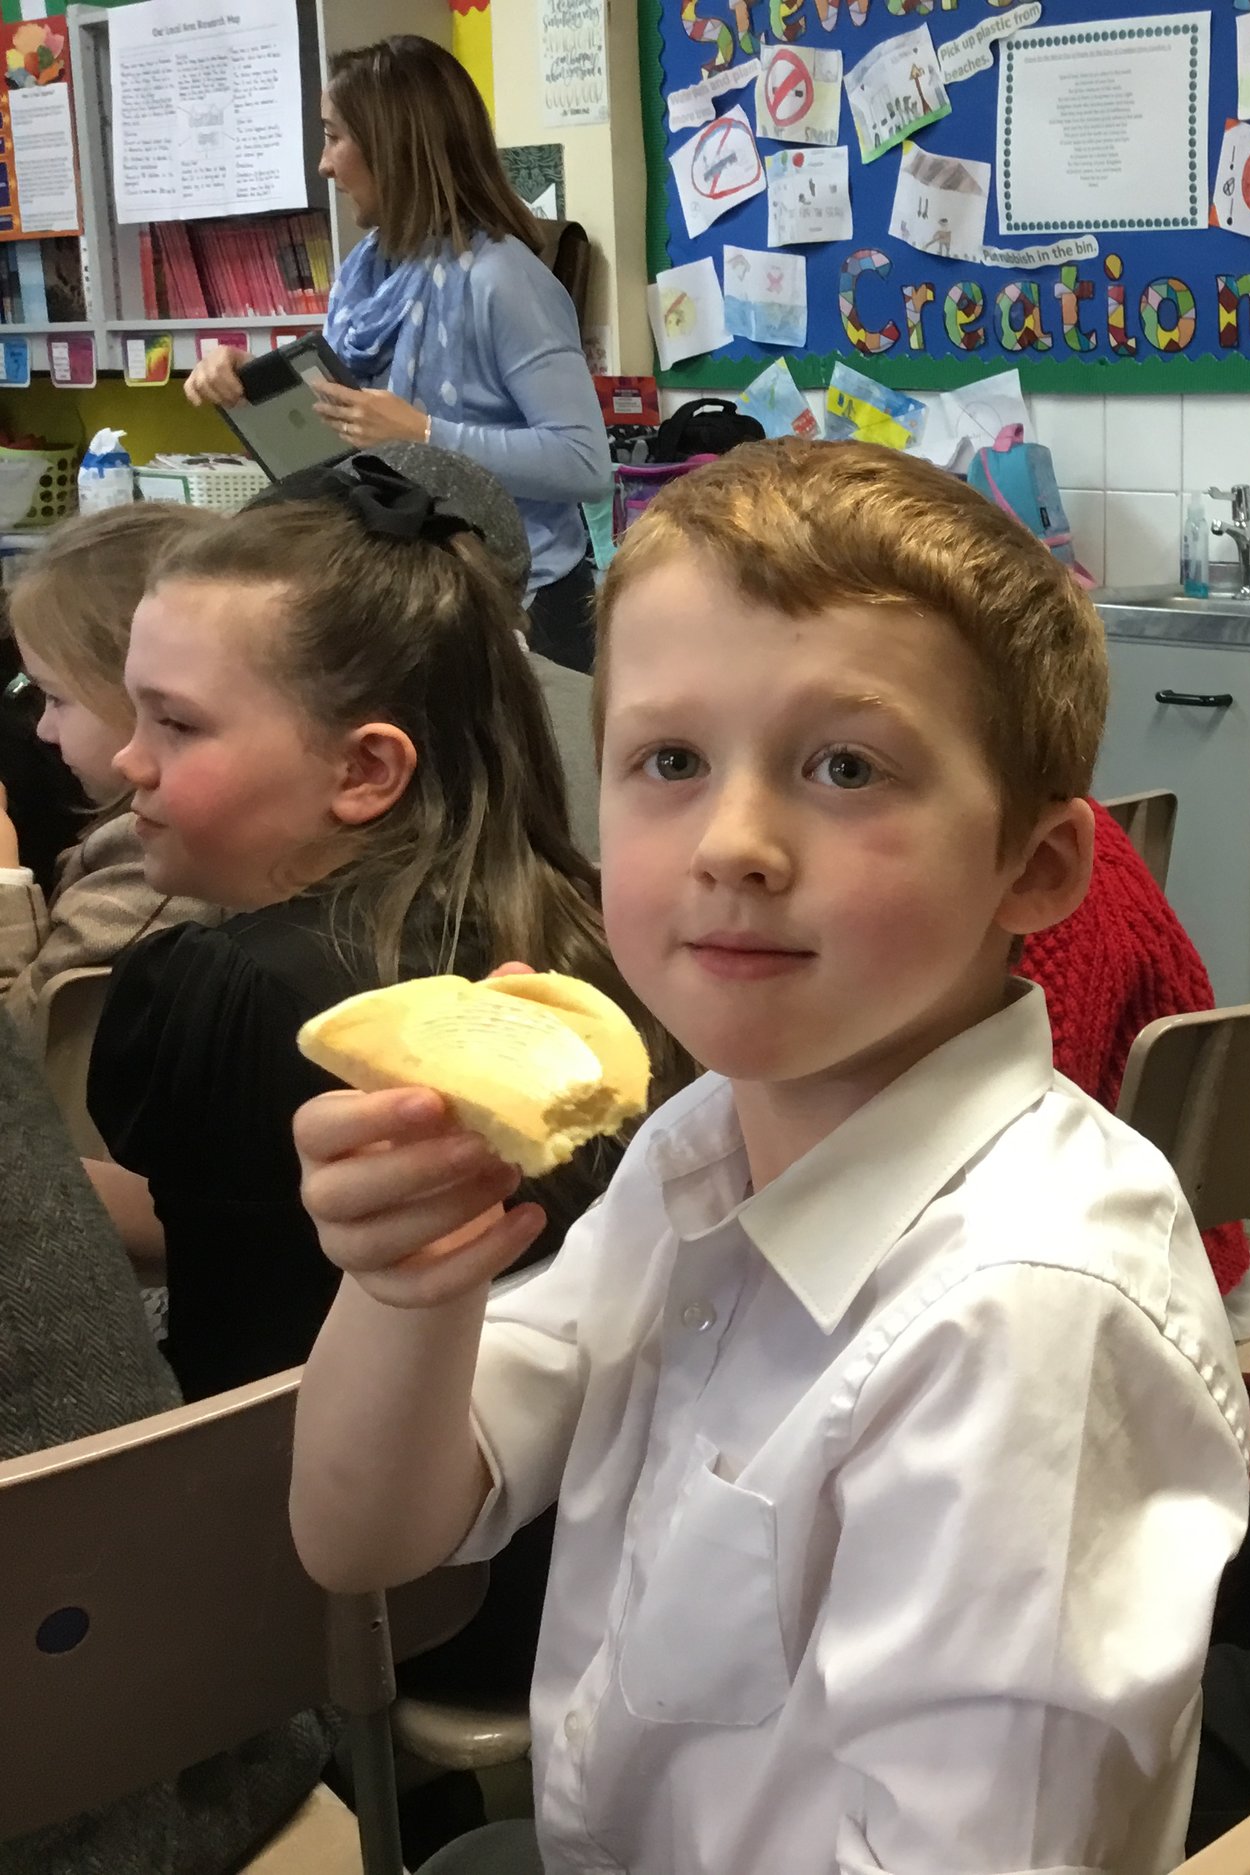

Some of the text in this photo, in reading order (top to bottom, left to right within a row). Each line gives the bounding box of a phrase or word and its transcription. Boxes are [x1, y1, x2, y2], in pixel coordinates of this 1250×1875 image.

[940, 5, 1040, 60] Pick up plastic from
[944, 54, 990, 82] beaches.
[1037, 249, 1050, 262] in
[1052, 243, 1074, 259] the
[1075, 240, 1097, 255] bin.
